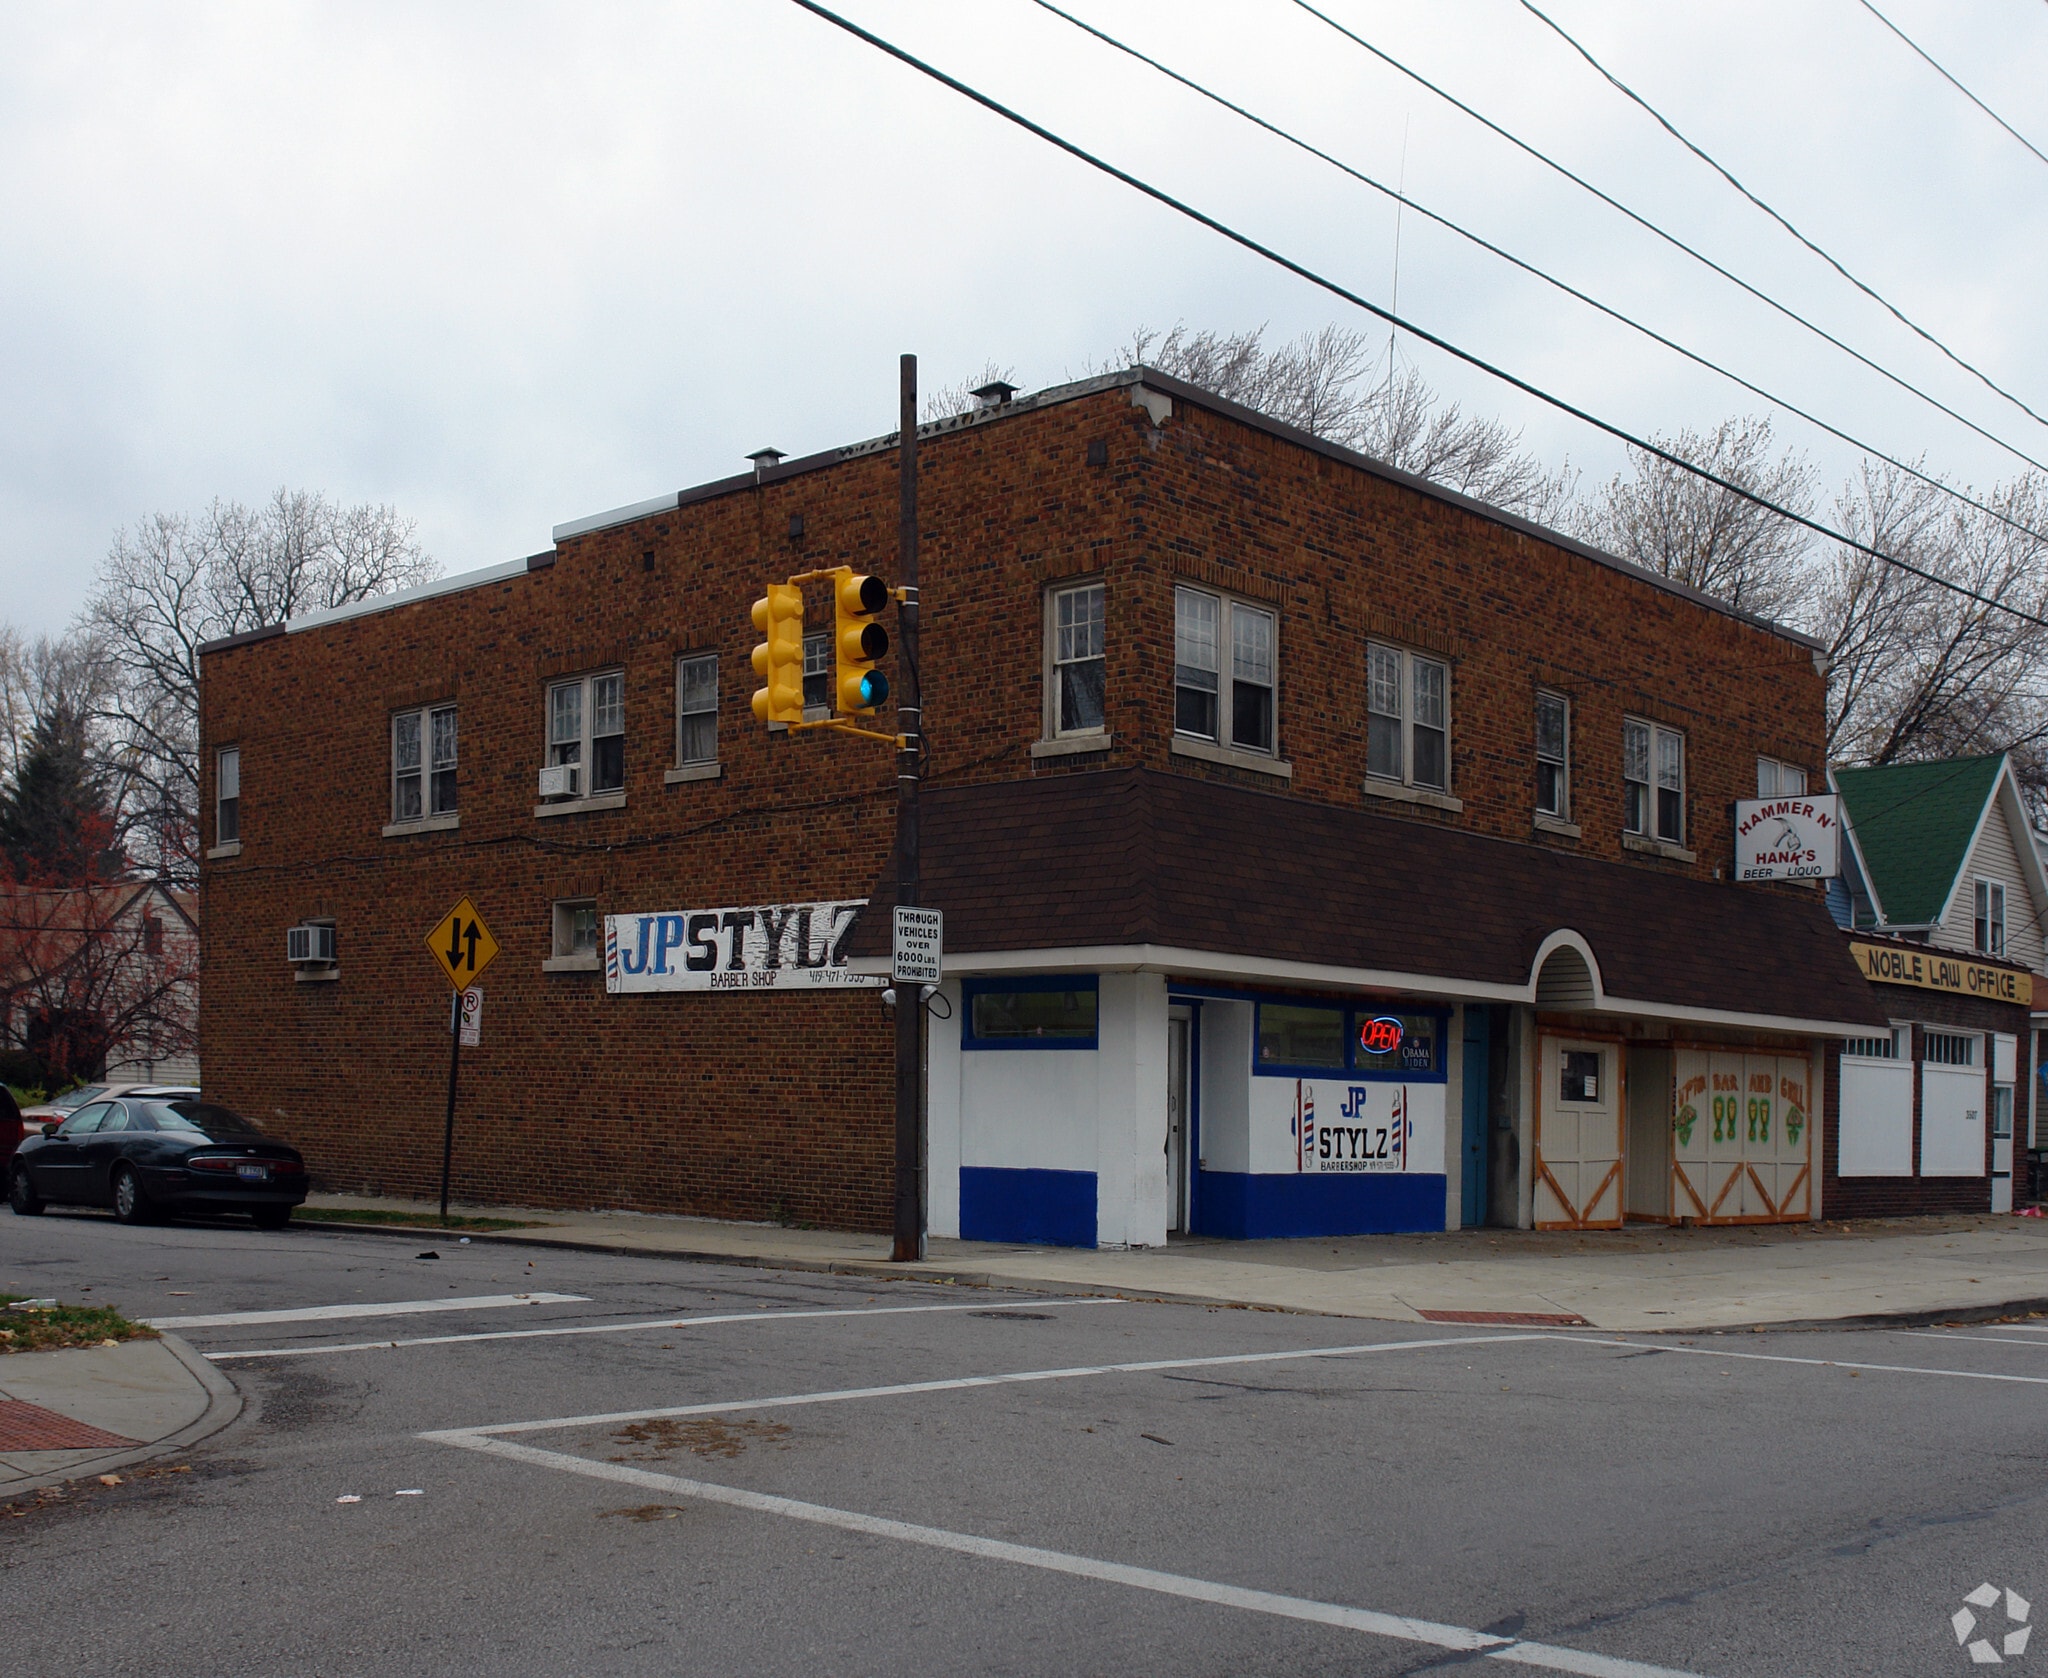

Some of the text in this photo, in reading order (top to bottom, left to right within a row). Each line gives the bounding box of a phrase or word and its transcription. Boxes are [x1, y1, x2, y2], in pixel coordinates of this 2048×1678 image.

[1738, 801, 1814, 836] HAMMER
[1756, 849, 1816, 866] HANK'S
[1743, 865, 1822, 879] BEER LIQUO
[897, 911, 938, 925] THROUGH
[898, 926, 938, 939] VEHICLES
[906, 941, 930, 949] OVER
[897, 951, 923, 963] 6000
[897, 965, 937, 978] PROHIBITED
[1868, 949, 2015, 998] NOBLE LAW OFFICE
[711, 972, 748, 988] BARBER
[752, 971, 777, 986] SHOP
[1362, 1020, 1401, 1051] OPEN
[1402, 1046, 1430, 1059] OBAMA
[1749, 1074, 1773, 1093] AND
[1319, 1127, 1388, 1159] STYLZ
